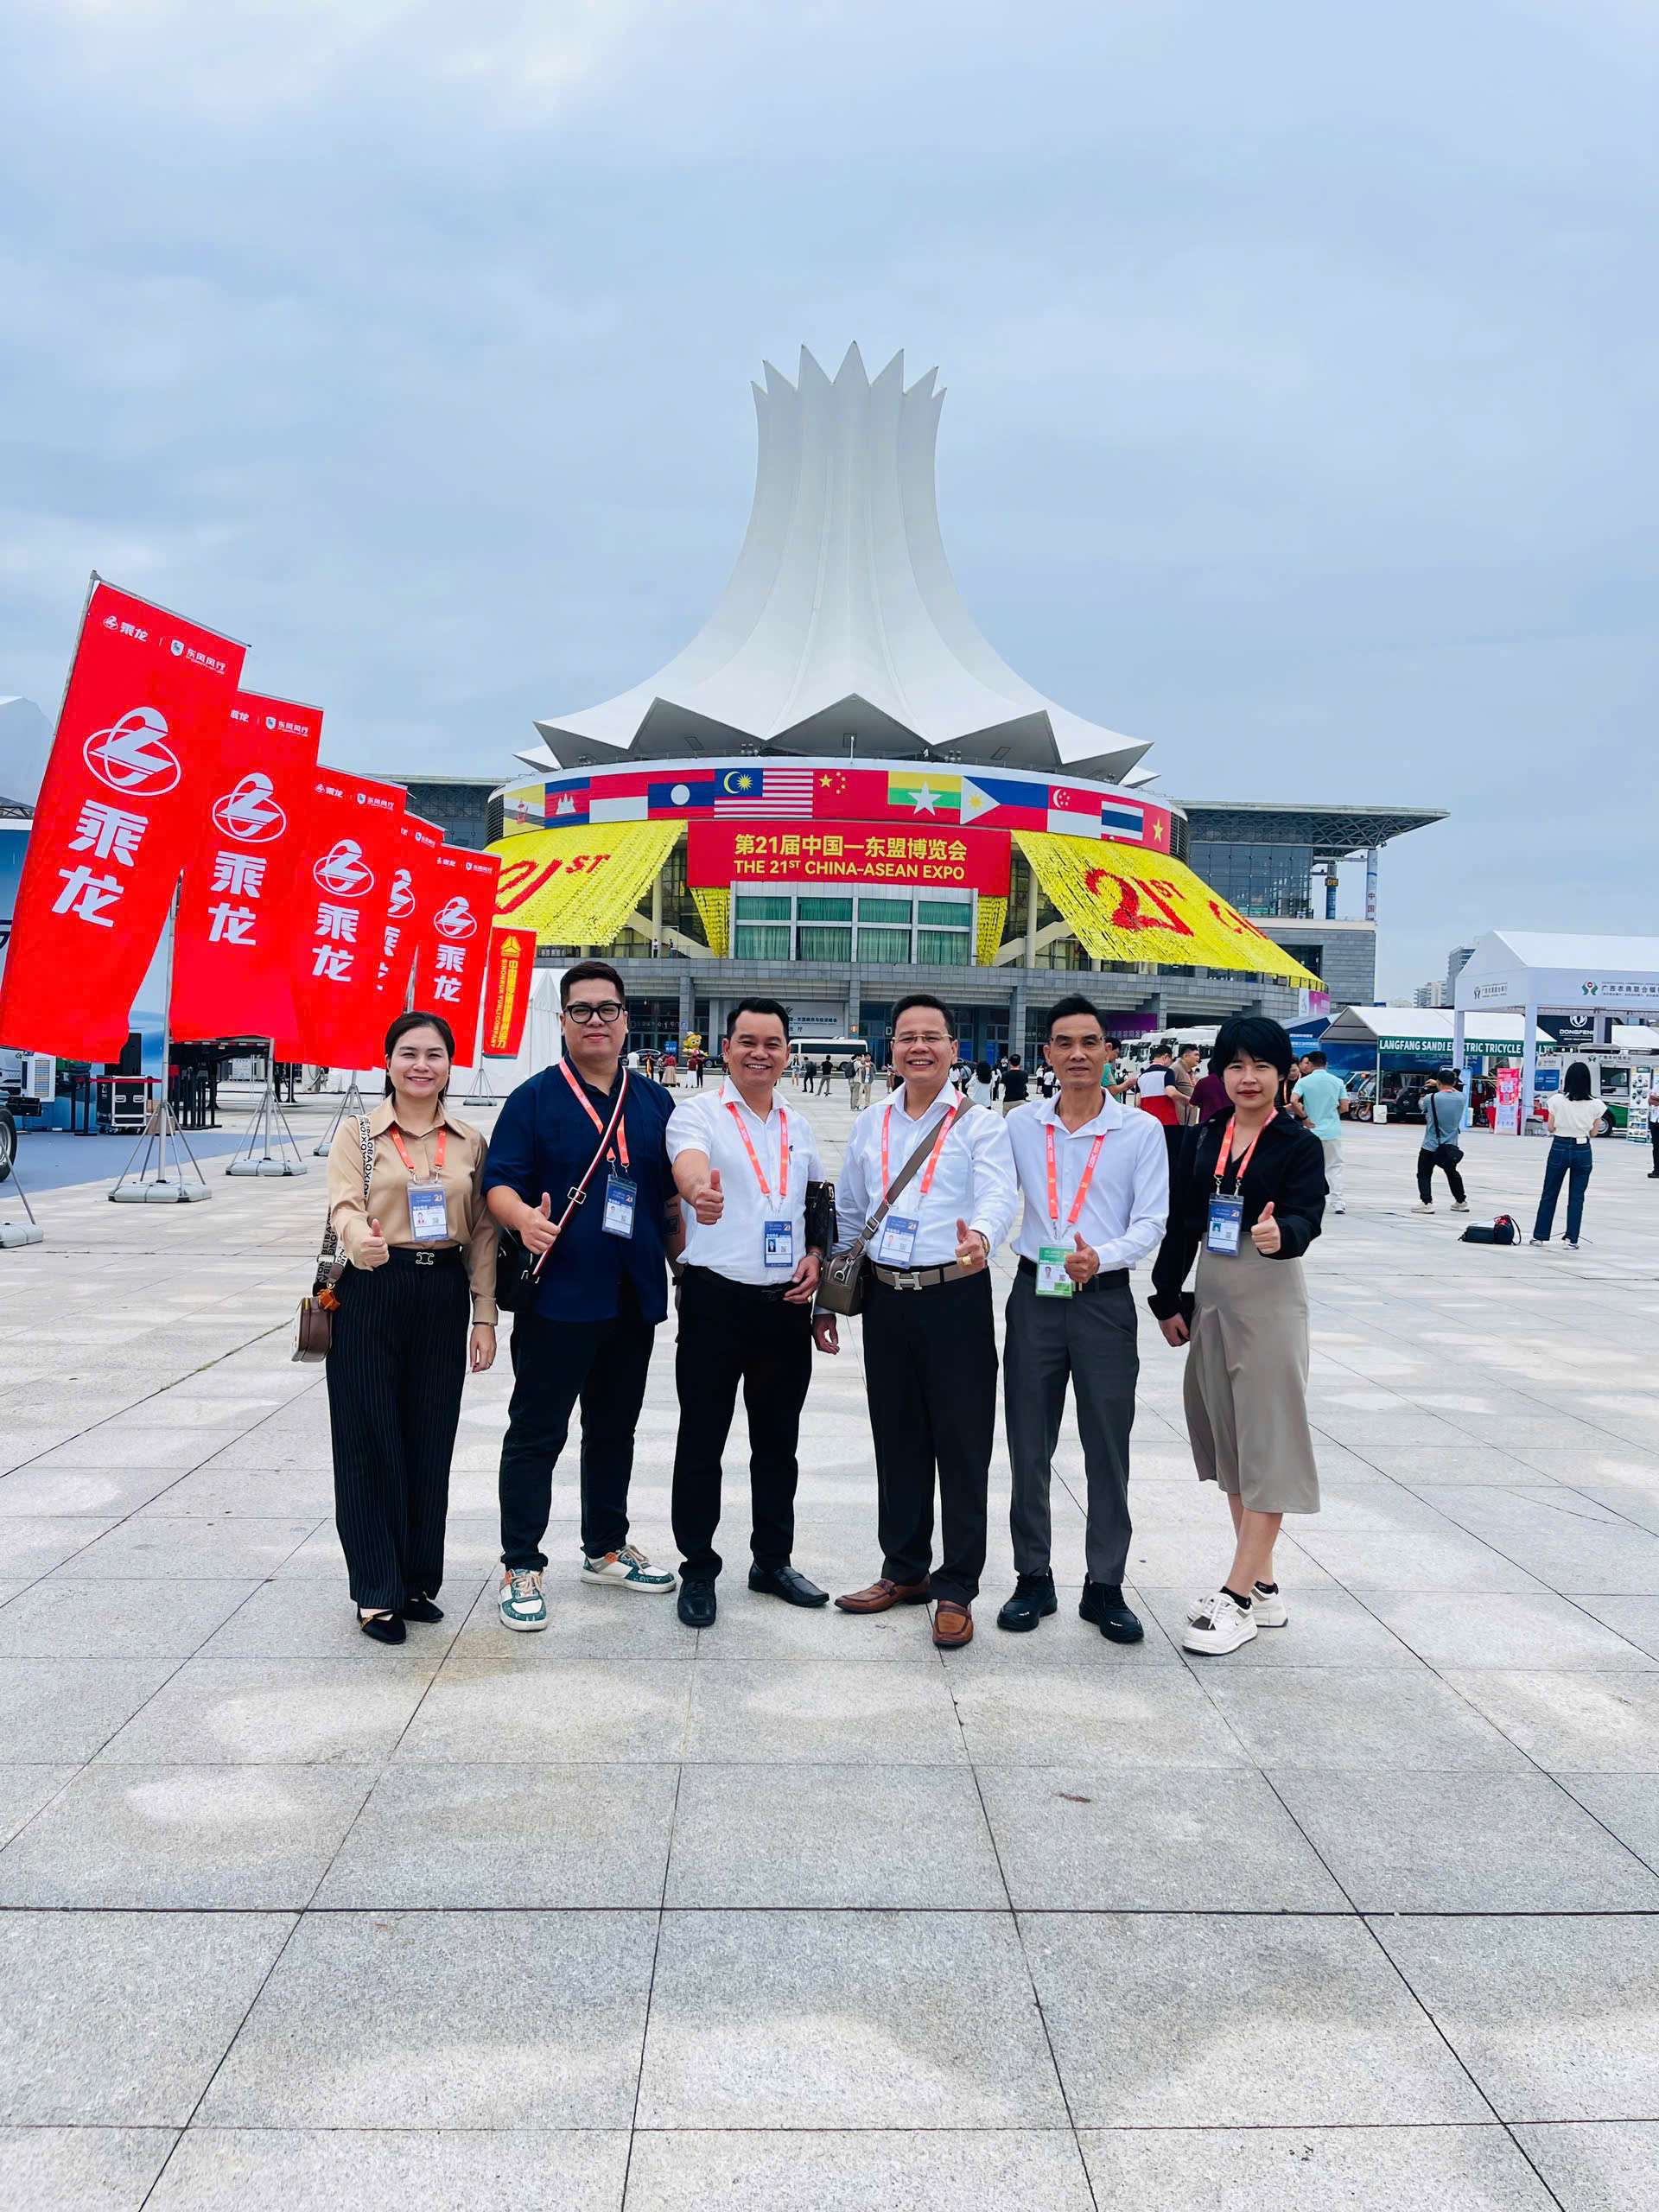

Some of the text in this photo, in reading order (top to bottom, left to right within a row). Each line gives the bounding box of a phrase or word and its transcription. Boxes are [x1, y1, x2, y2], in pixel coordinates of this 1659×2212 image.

[51, 799, 149, 928] 乘龙
[207, 850, 267, 946] 乘龙
[734, 860, 966, 880] THE 21ST CHINA-ASEAN EXPO
[312, 902, 360, 982] 乘龙
[434, 944, 467, 1003] 乘龙
[1379, 1039, 1421, 1051] LANGFANG
[1421, 1040, 1446, 1052] SANDI
[1484, 1043, 1522, 1053] TRICYCLE
